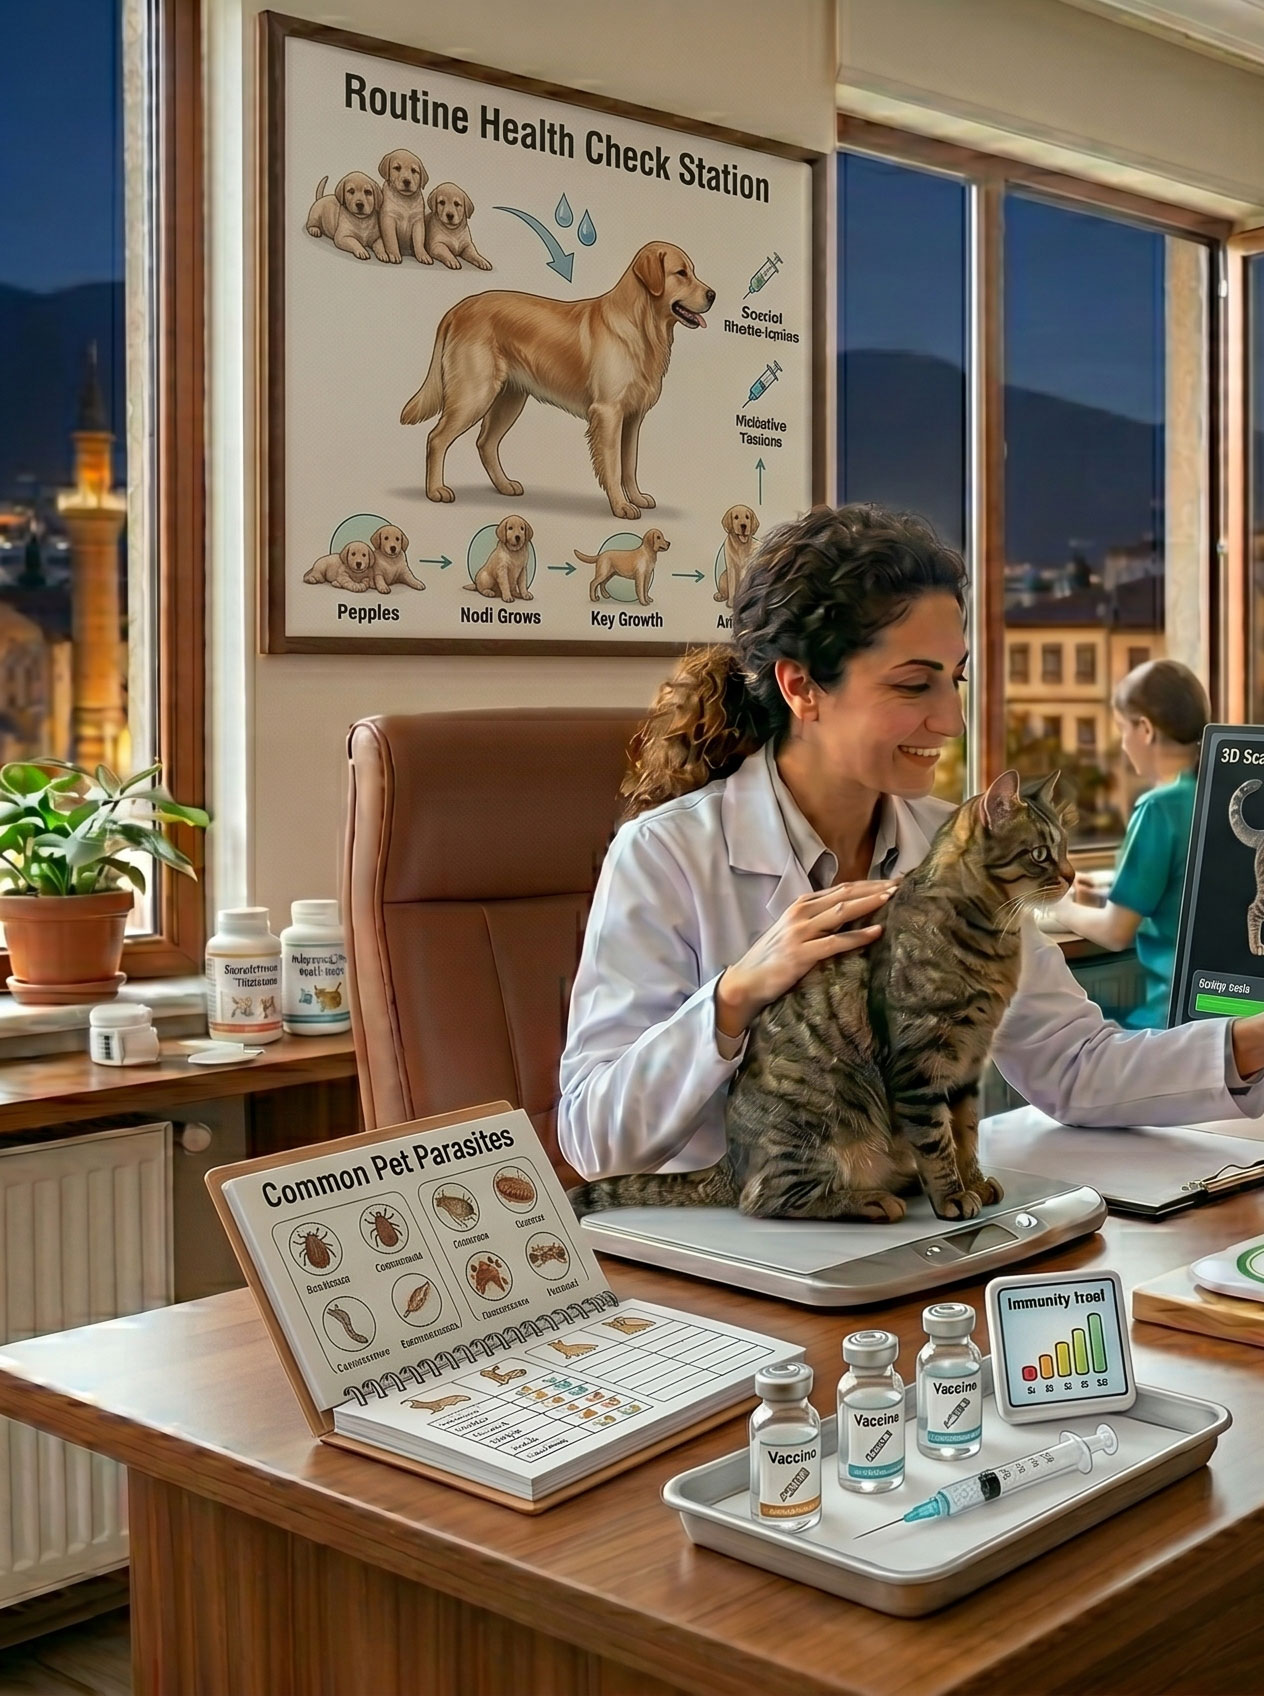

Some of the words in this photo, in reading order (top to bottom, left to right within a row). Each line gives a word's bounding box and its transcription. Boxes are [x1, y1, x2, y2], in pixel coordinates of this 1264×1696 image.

[345, 73, 468, 133] Routine
[480, 105, 574, 158] Health
[585, 131, 670, 180] Check
[679, 153, 769, 203] Station
[337, 604, 400, 623] Pepples
[461, 608, 493, 623] Nodi
[497, 609, 541, 625] Grows
[591, 612, 615, 628] Key
[618, 613, 663, 628] Growth
[1221, 748, 1239, 763] 3D
[262, 1166, 371, 1208] Common
[371, 1154, 414, 1181] Pet
[412, 1129, 514, 1170] Parasites
[1008, 1294, 1070, 1310] Immunity
